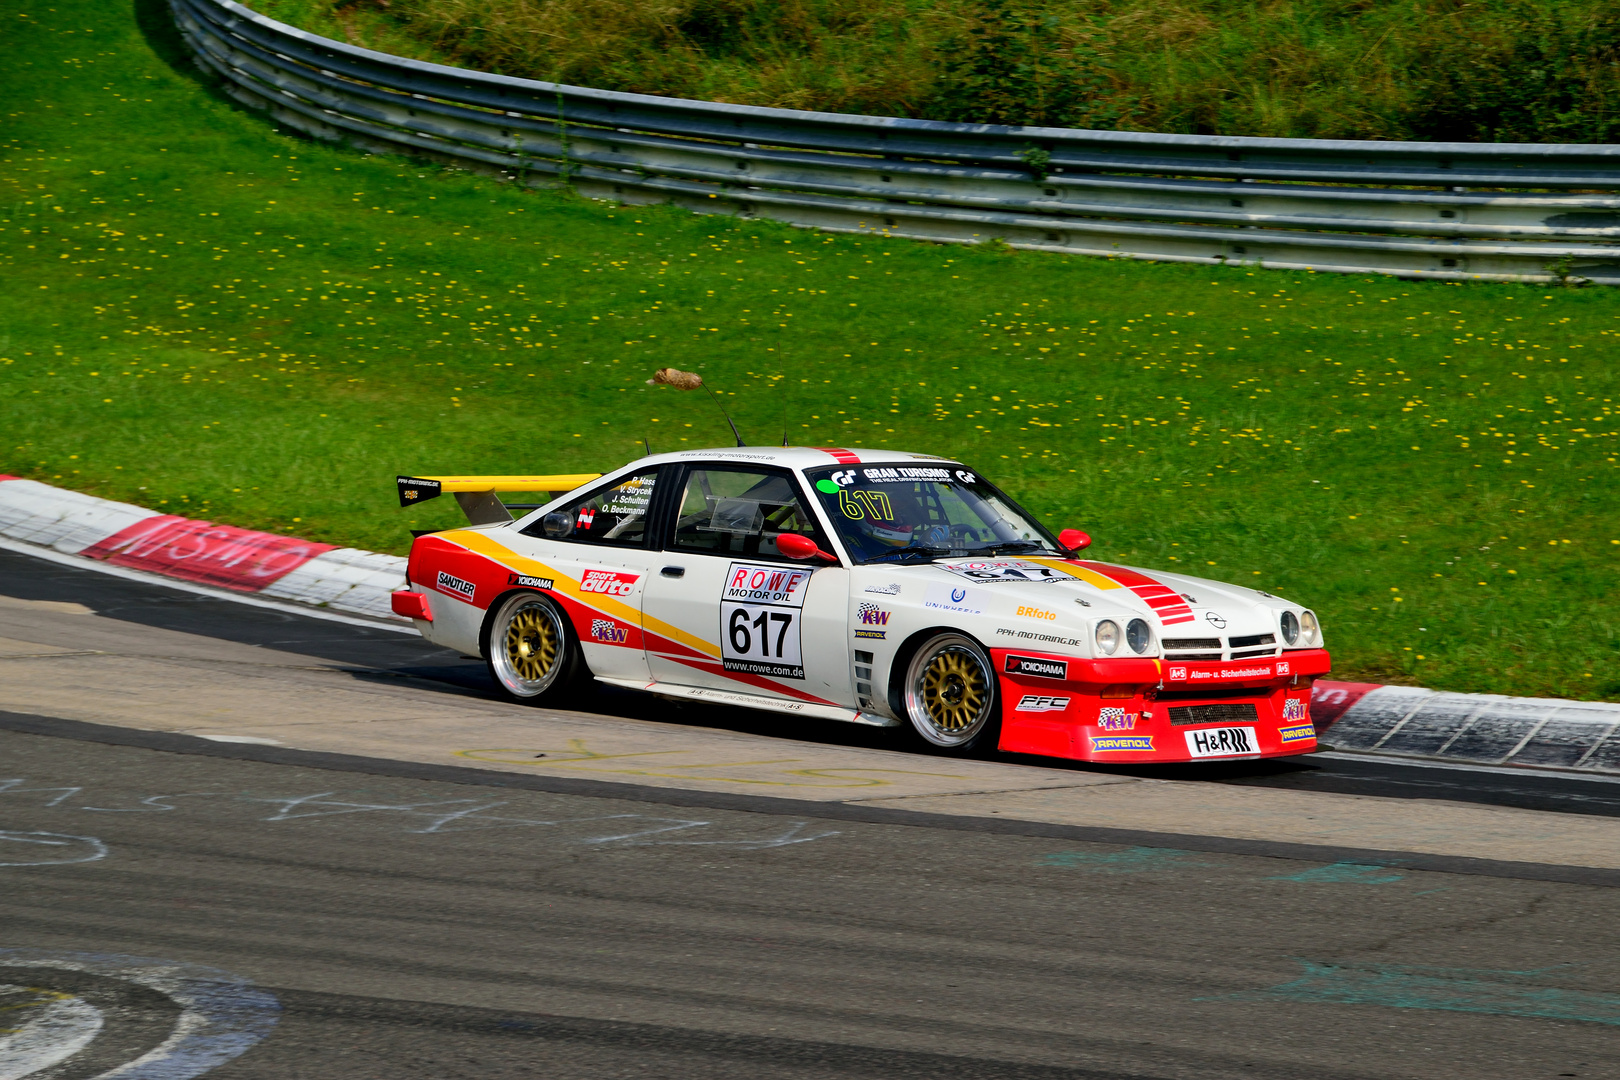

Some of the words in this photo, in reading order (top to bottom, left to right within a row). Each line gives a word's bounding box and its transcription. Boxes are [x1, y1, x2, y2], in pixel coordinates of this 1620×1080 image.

[631, 476, 639, 485] P.
[638, 476, 657, 486] Hass
[863, 468, 900, 479] GRAN
[896, 468, 951, 478] TURISMO
[620, 485, 627, 493] V.
[626, 485, 653, 496] Strycek
[611, 494, 619, 503] J.
[619, 495, 649, 505] Schulten
[838, 489, 894, 520] 617
[601, 504, 610, 513] O.
[610, 504, 646, 515] Beckmann
[517, 576, 552, 589] YOKOHAMA
[586, 571, 617, 580] sport
[730, 568, 803, 593] ROWE
[438, 572, 475, 596] SANDTLER
[580, 579, 635, 596] auto
[728, 588, 770, 600] MOTOR
[772, 592, 791, 602] OIL
[862, 609, 892, 626] KW
[1015, 605, 1057, 621] BRfoto
[597, 627, 629, 643] KW
[729, 608, 793, 658] 617
[995, 628, 1082, 647] PPH-MOTORING.DE
[723, 661, 804, 678] www.rowe.com.de
[1020, 661, 1064, 676] YOKOHAMA
[1190, 670, 1213, 679] Alarm-
[1220, 666, 1271, 678] Sicherheitstechnik
[1020, 695, 1070, 708] PFC
[1105, 713, 1139, 731] KW
[1283, 727, 1316, 739] RAVENOL
[1097, 739, 1149, 748] RAVENOL
[1193, 730, 1233, 753] H&R
